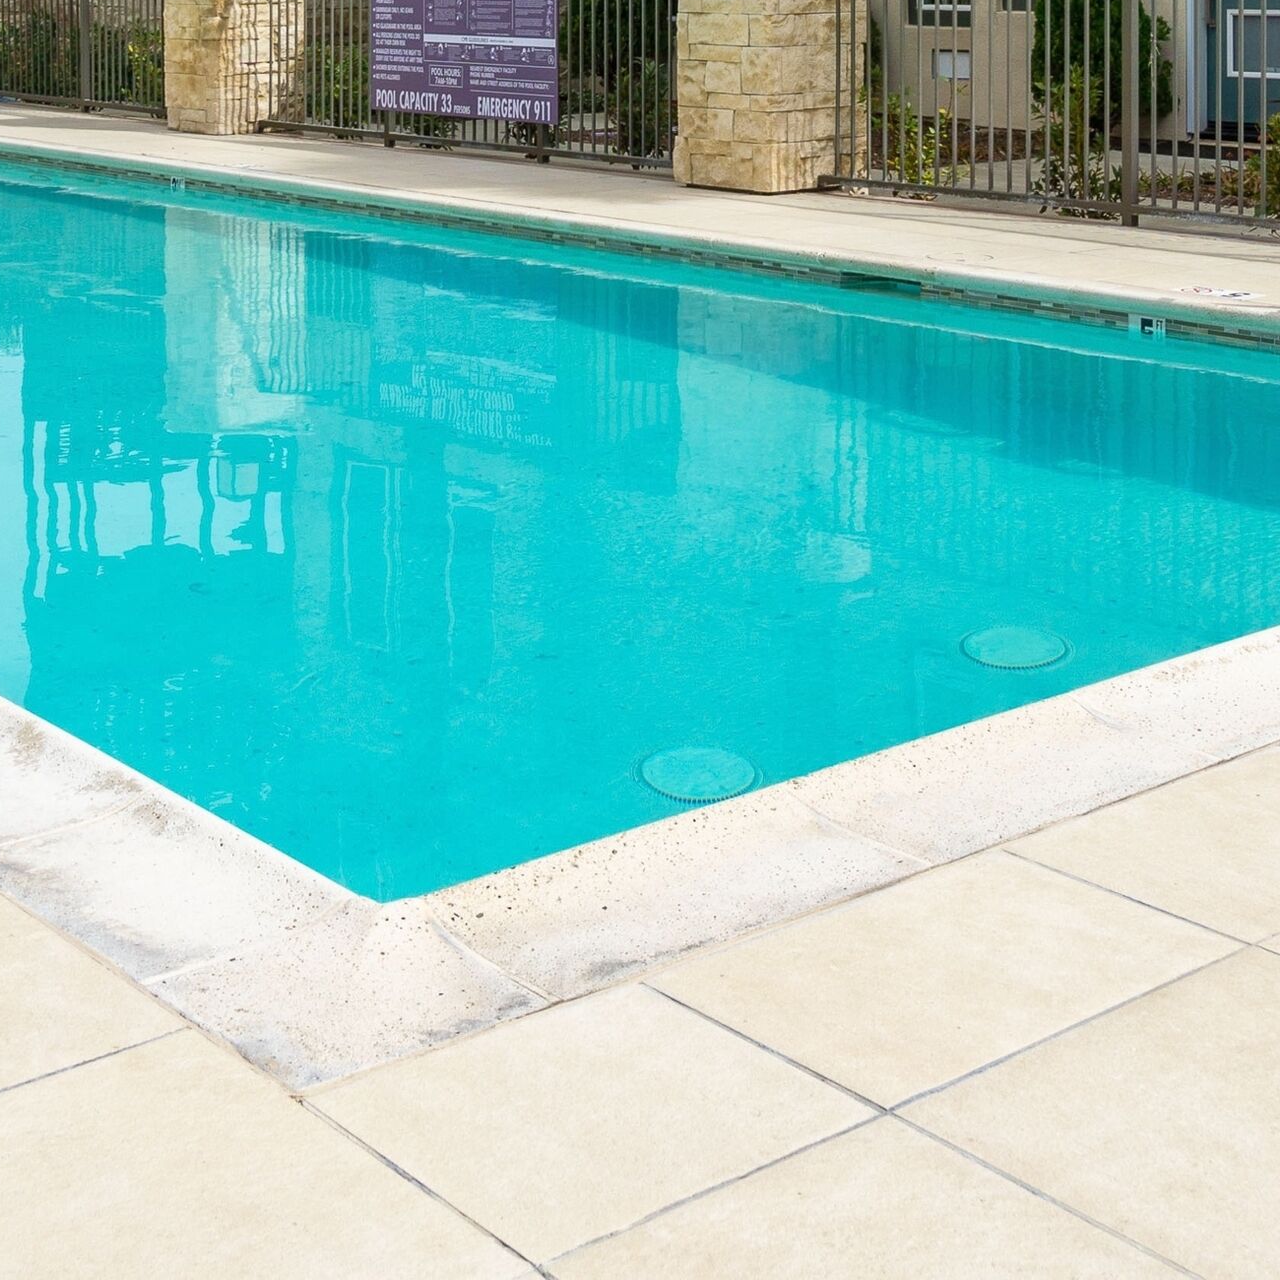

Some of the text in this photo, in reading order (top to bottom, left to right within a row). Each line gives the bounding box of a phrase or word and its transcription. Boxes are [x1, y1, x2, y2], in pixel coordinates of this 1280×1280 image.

[430, 67, 444, 77] POOL
[376, 89, 471, 114] POOL CAPACITY 33 PERSONS
[477, 96, 551, 121] EMERGENCY 911
